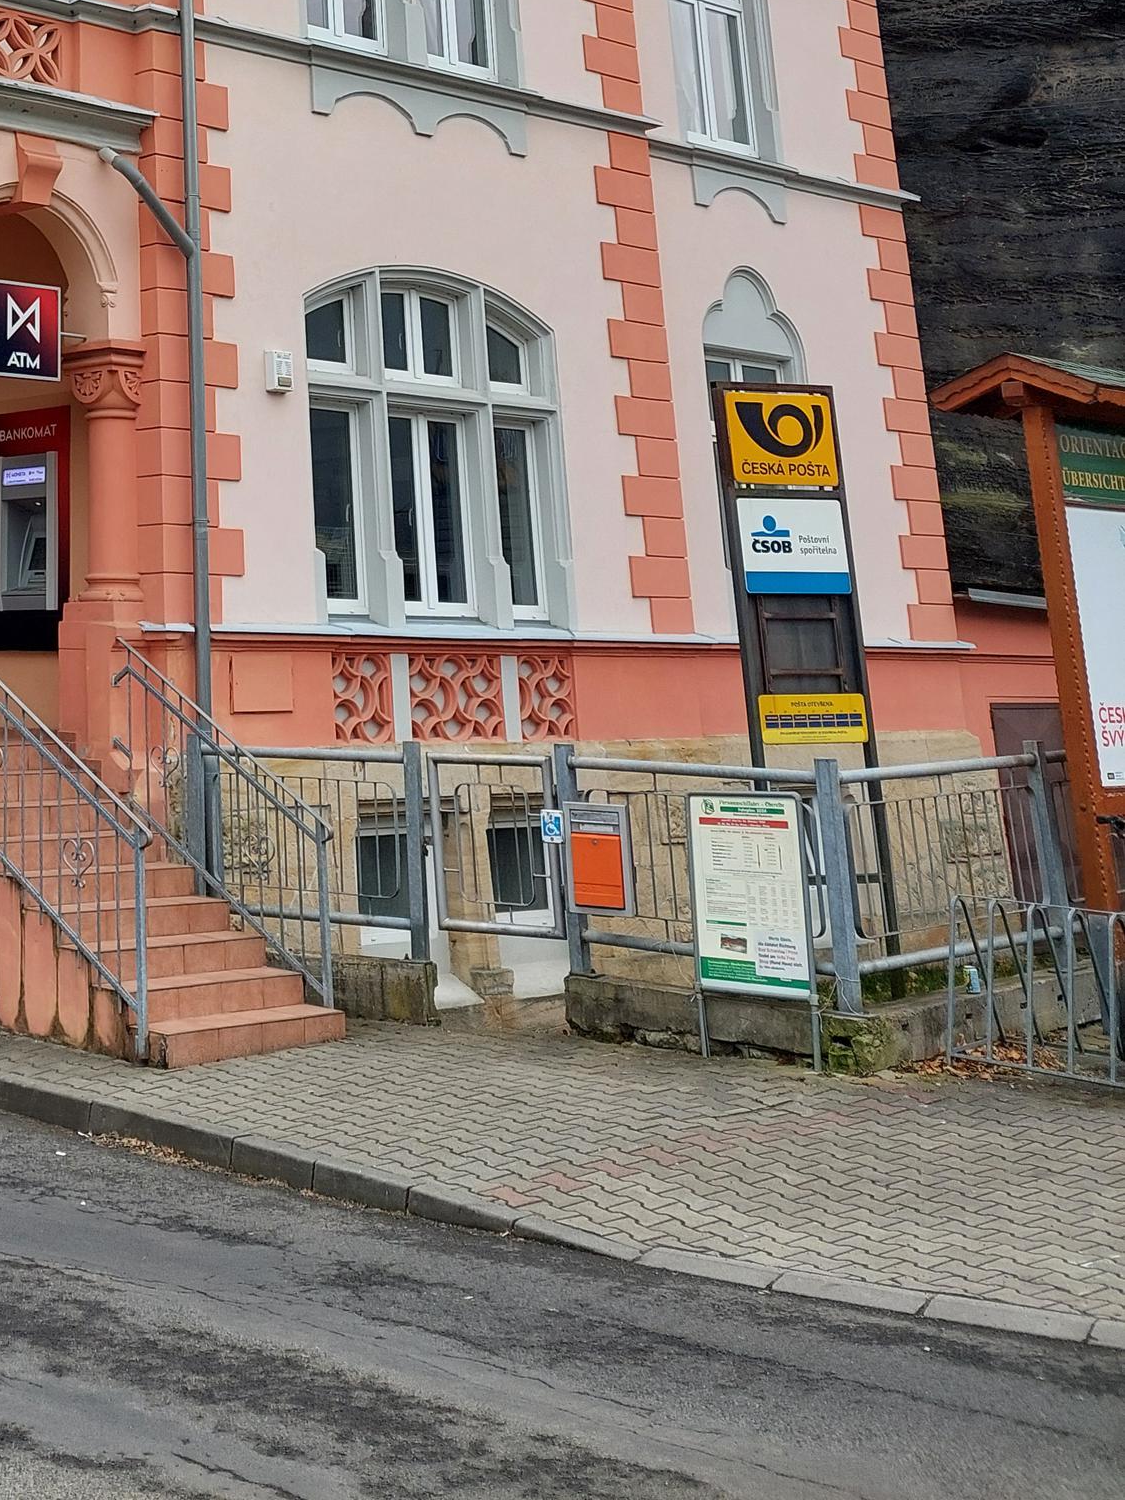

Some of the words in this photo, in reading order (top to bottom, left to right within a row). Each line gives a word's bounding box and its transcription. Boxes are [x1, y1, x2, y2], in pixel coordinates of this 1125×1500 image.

[6, 350, 40, 370] ATM
[0, 423, 57, 443] BANKOMAT
[741, 458, 786, 476] ČESKÁ
[788, 461, 831, 478] POŠTA
[751, 538, 793, 554] ČSOB
[798, 534, 830, 544] Poštovní
[800, 545, 837, 556] spořitelna
[1099, 702, 1125, 723] ČES
